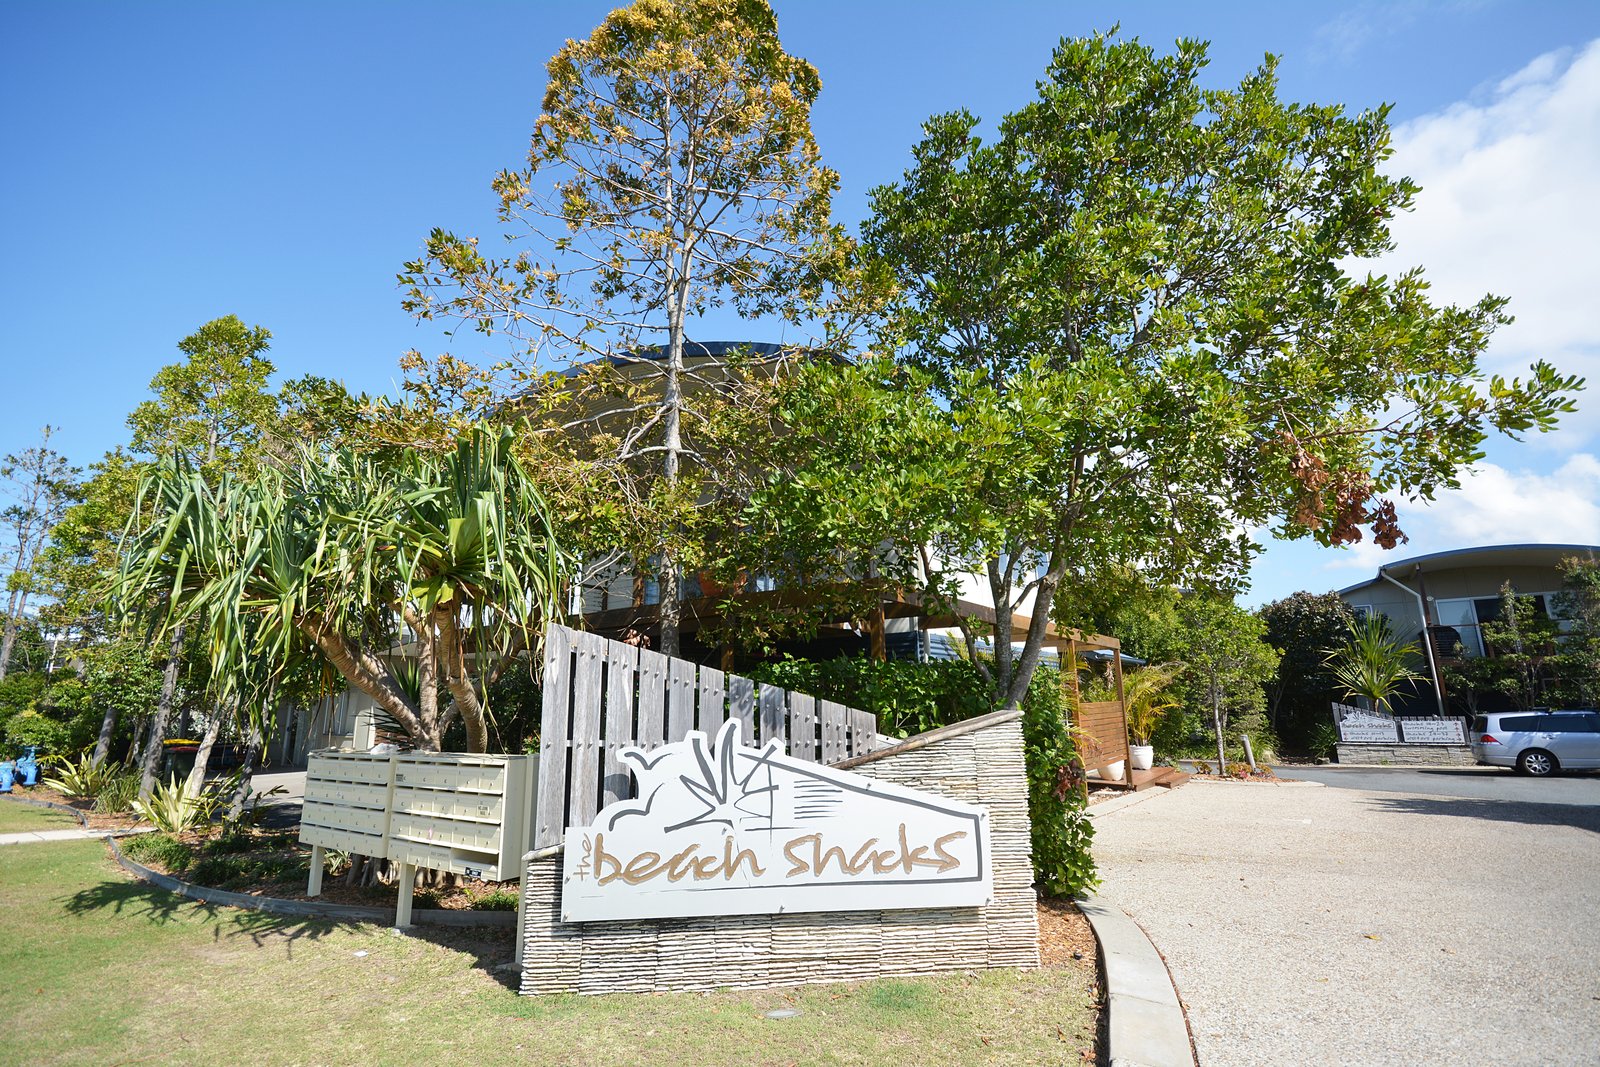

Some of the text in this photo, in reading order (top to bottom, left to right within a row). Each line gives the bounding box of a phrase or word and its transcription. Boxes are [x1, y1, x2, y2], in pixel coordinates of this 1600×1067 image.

[573, 823, 968, 886] the beach shacks
